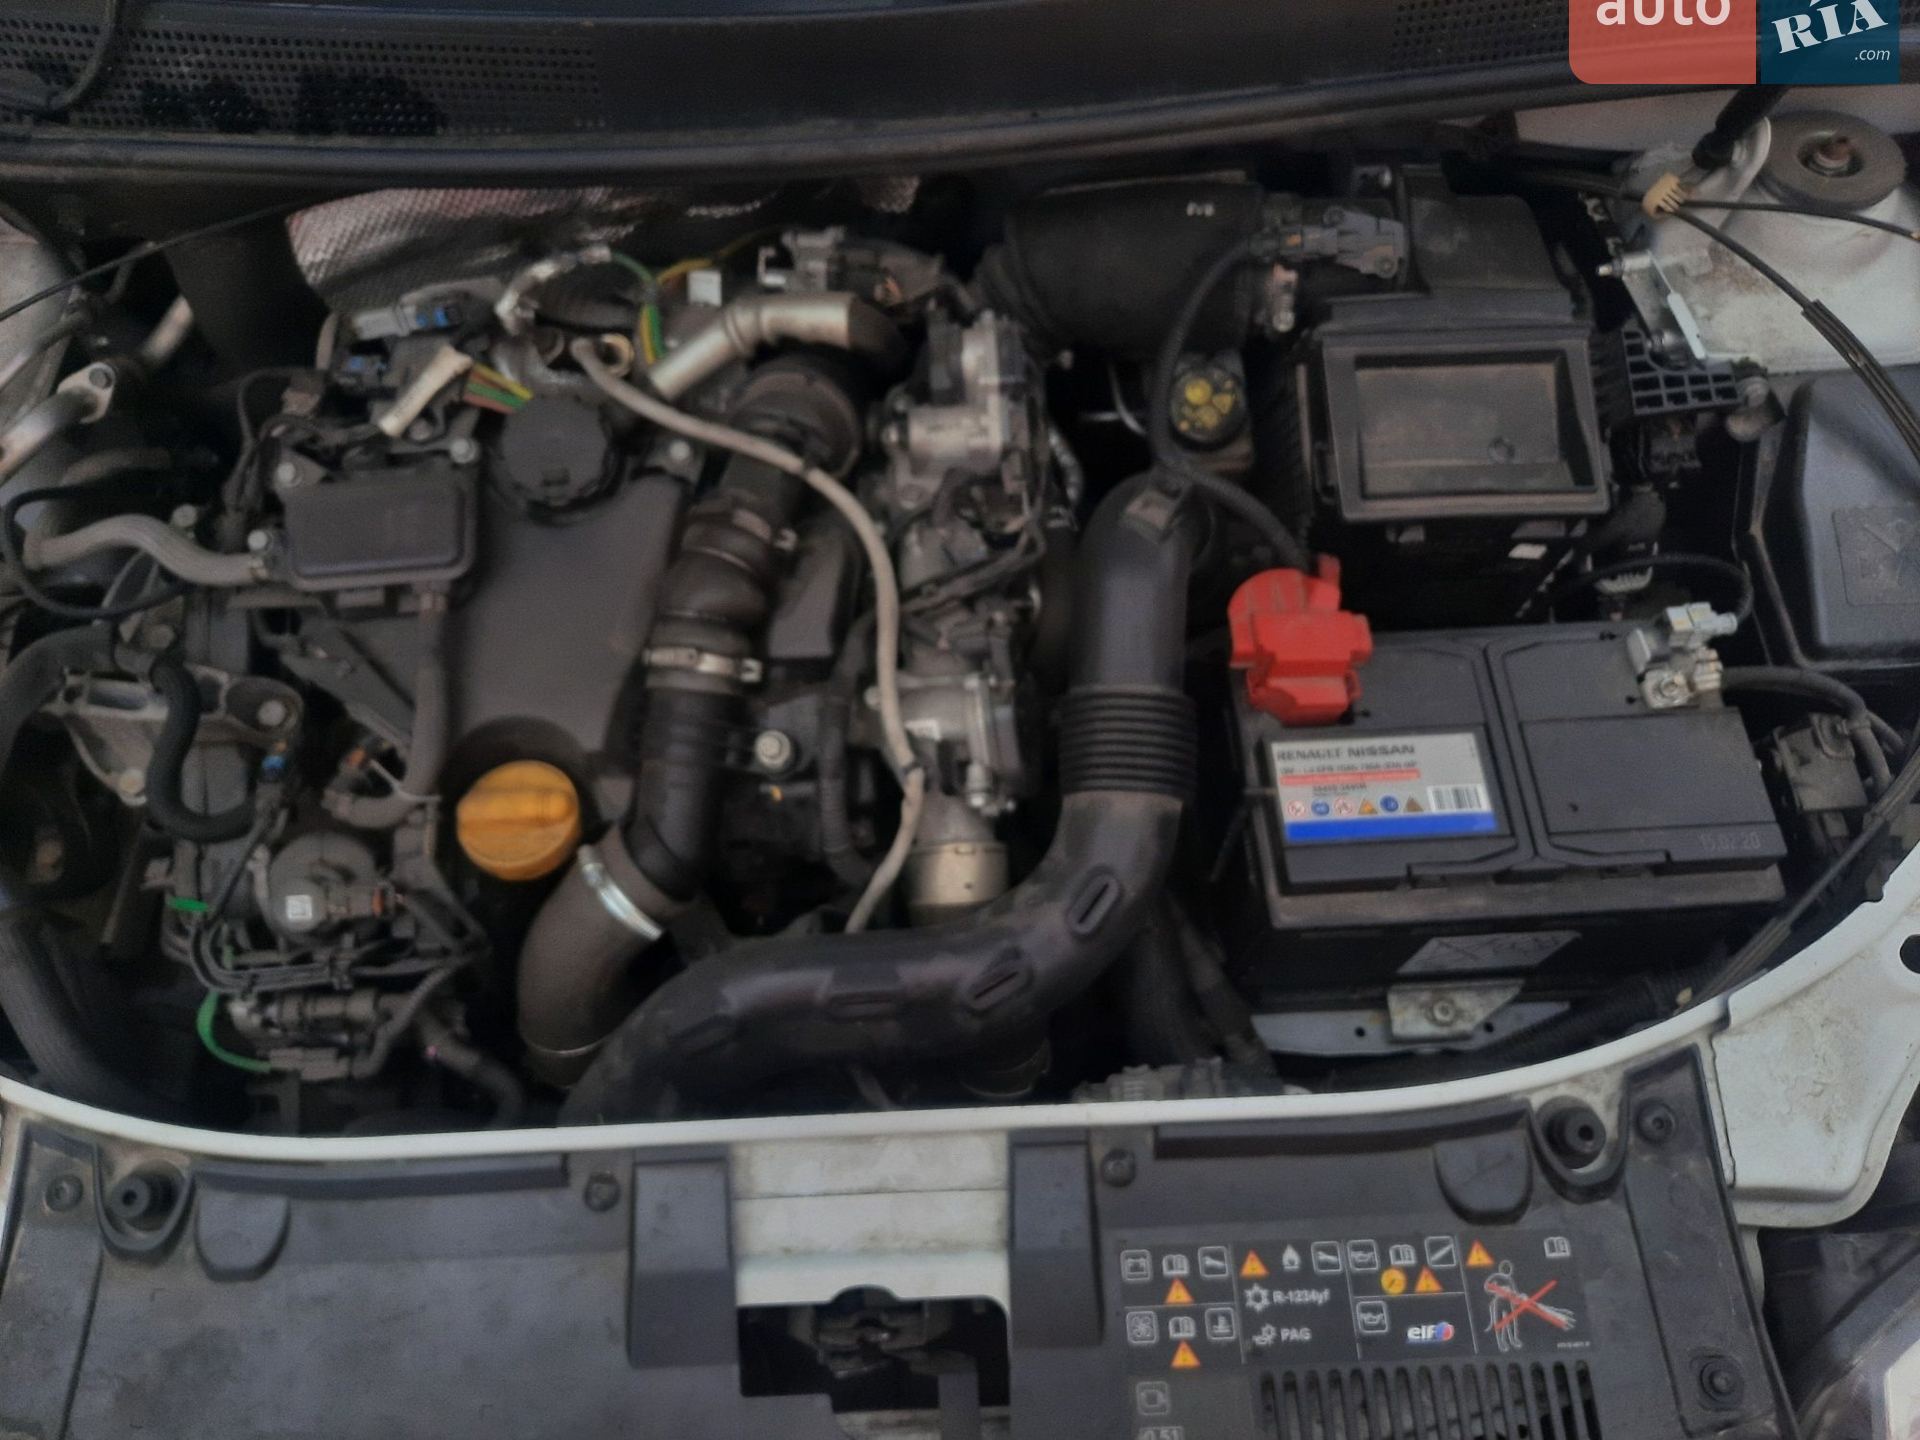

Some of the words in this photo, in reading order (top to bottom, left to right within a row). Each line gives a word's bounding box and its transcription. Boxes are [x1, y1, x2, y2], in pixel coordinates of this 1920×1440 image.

[1277, 747, 1342, 761] RENAULT
[1348, 743, 1416, 758] NISSAN
[1280, 1327, 1312, 1342] PAG
[1407, 1325, 1437, 1340] elf
